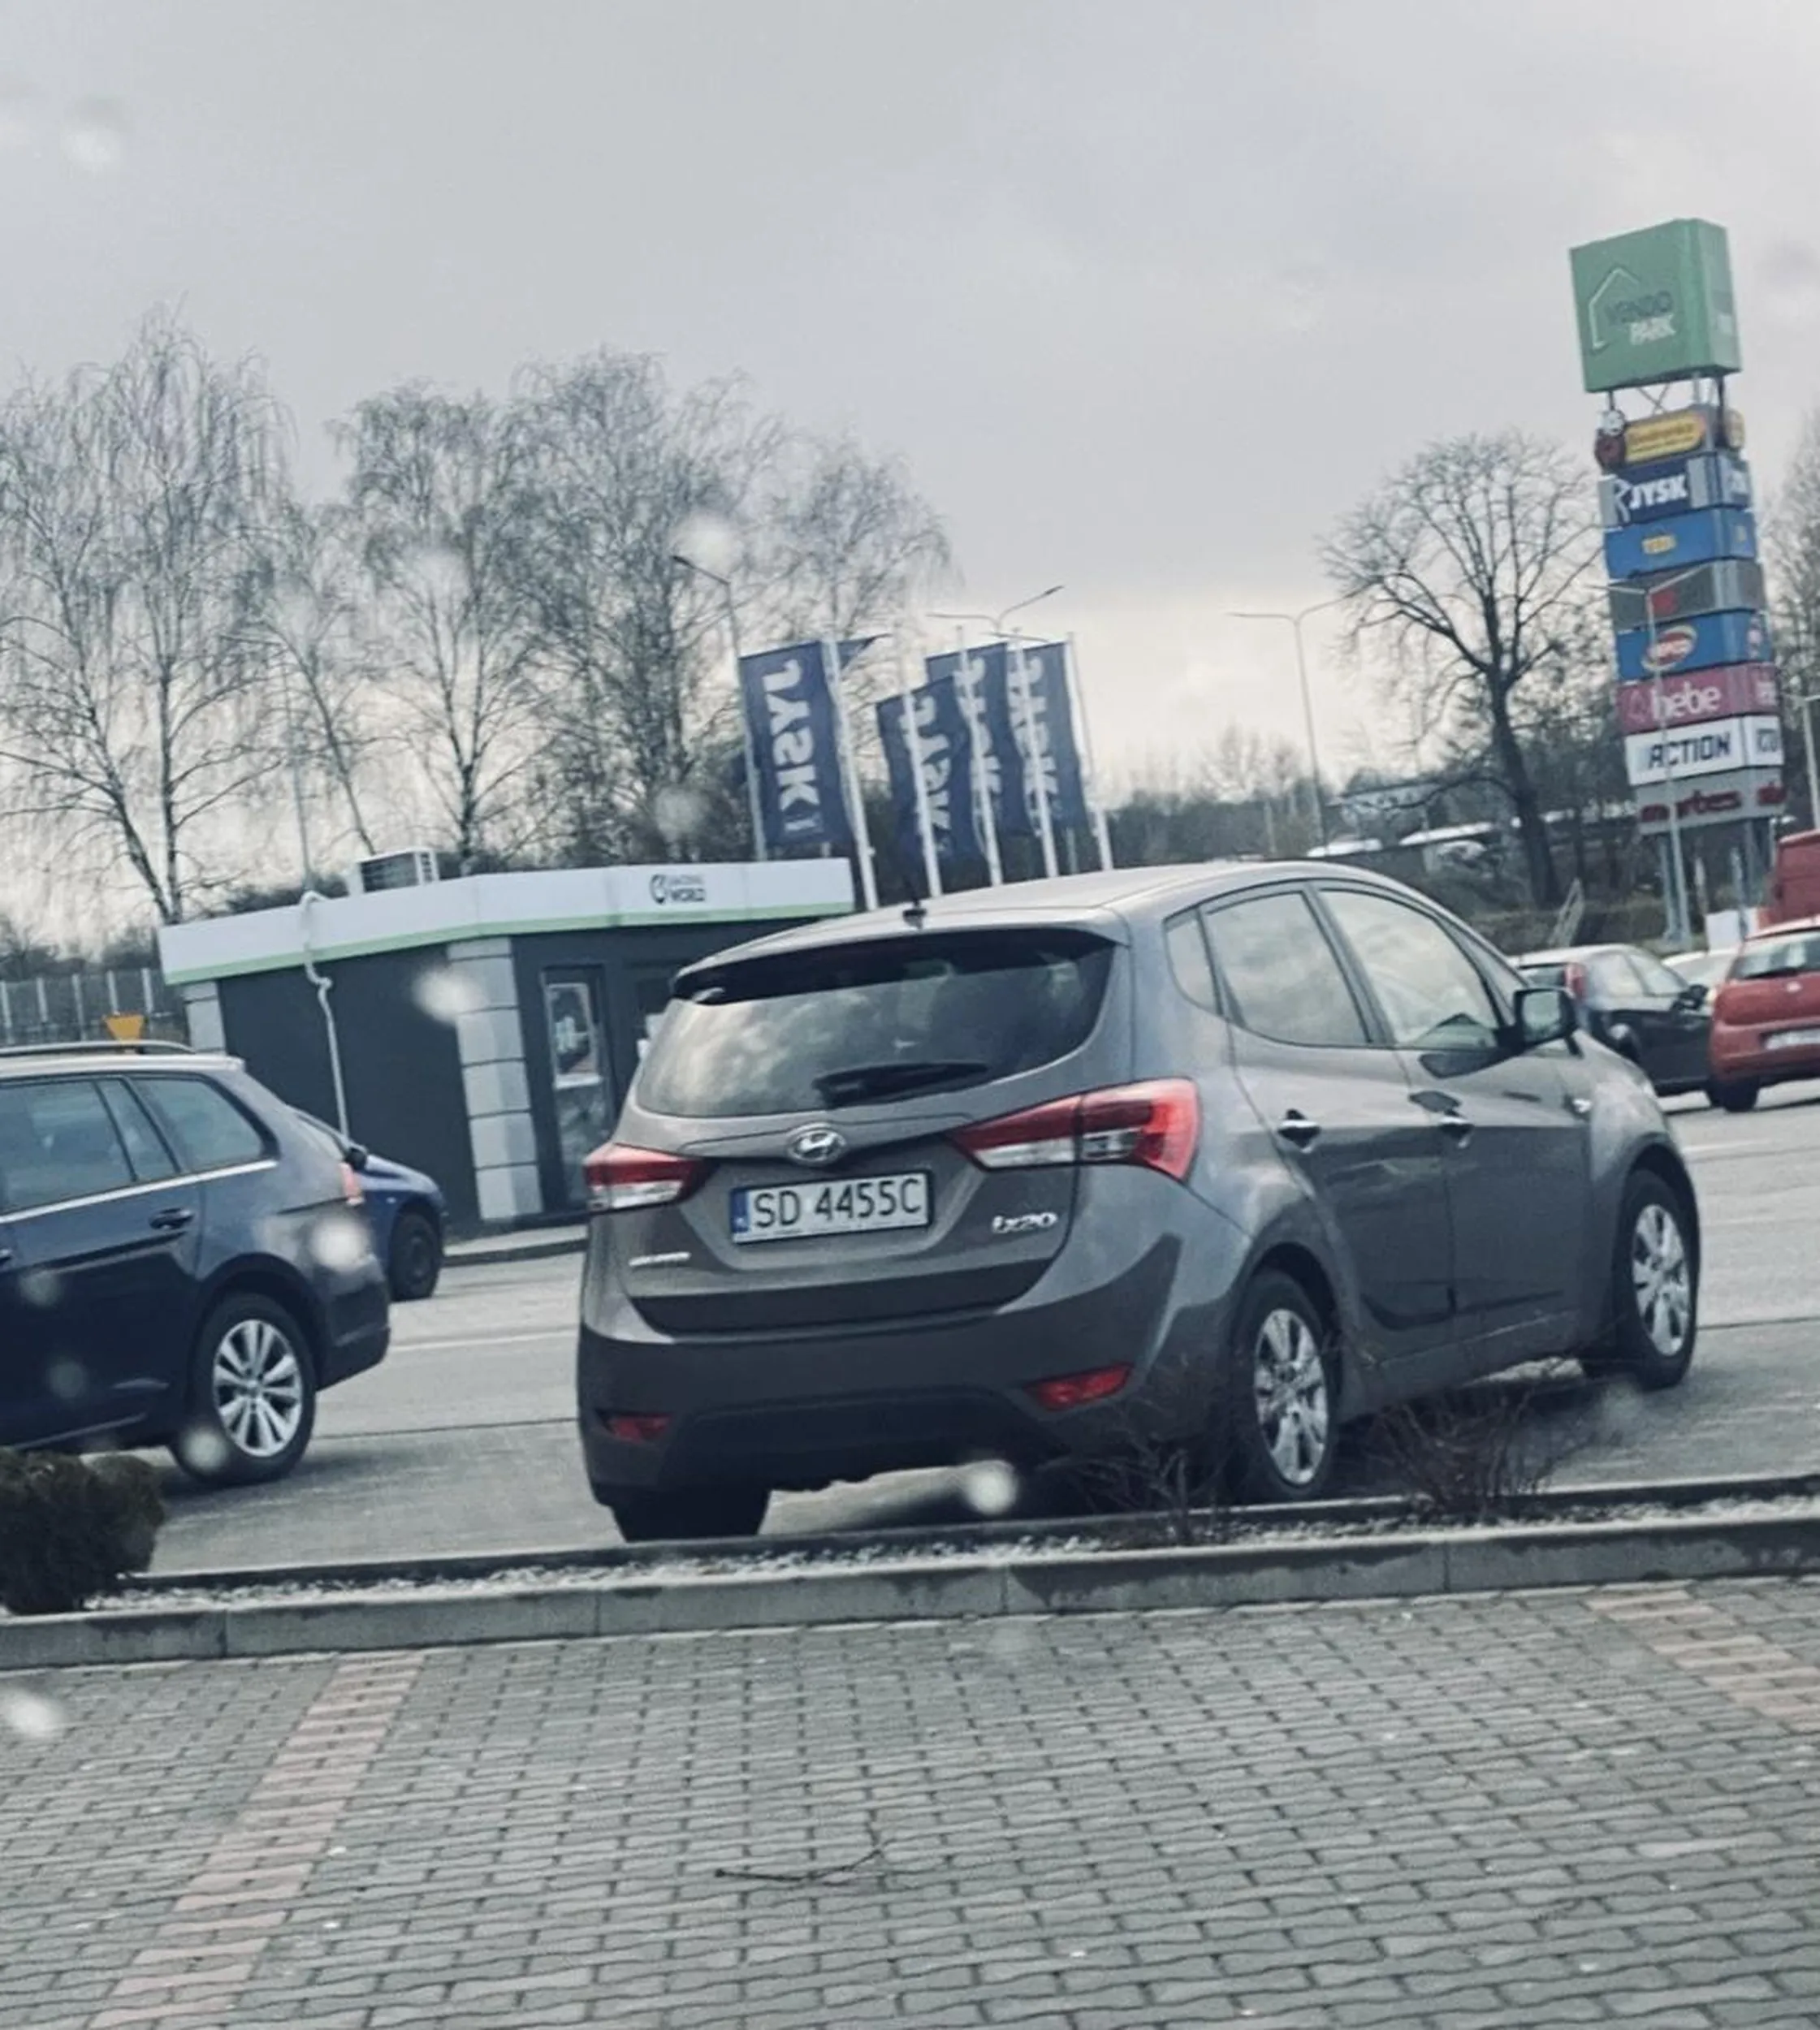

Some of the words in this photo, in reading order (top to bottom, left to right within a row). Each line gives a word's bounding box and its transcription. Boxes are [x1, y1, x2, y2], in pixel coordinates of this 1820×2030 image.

[1629, 473, 1688, 510] JYSK
[1650, 681, 1723, 721] hebe
[1649, 732, 1731, 768] ACTION
[1641, 790, 1742, 822] mrtes
[754, 1190, 801, 1228] SD
[814, 1177, 923, 1221] 4455C
[992, 1212, 1058, 1233] ix20
